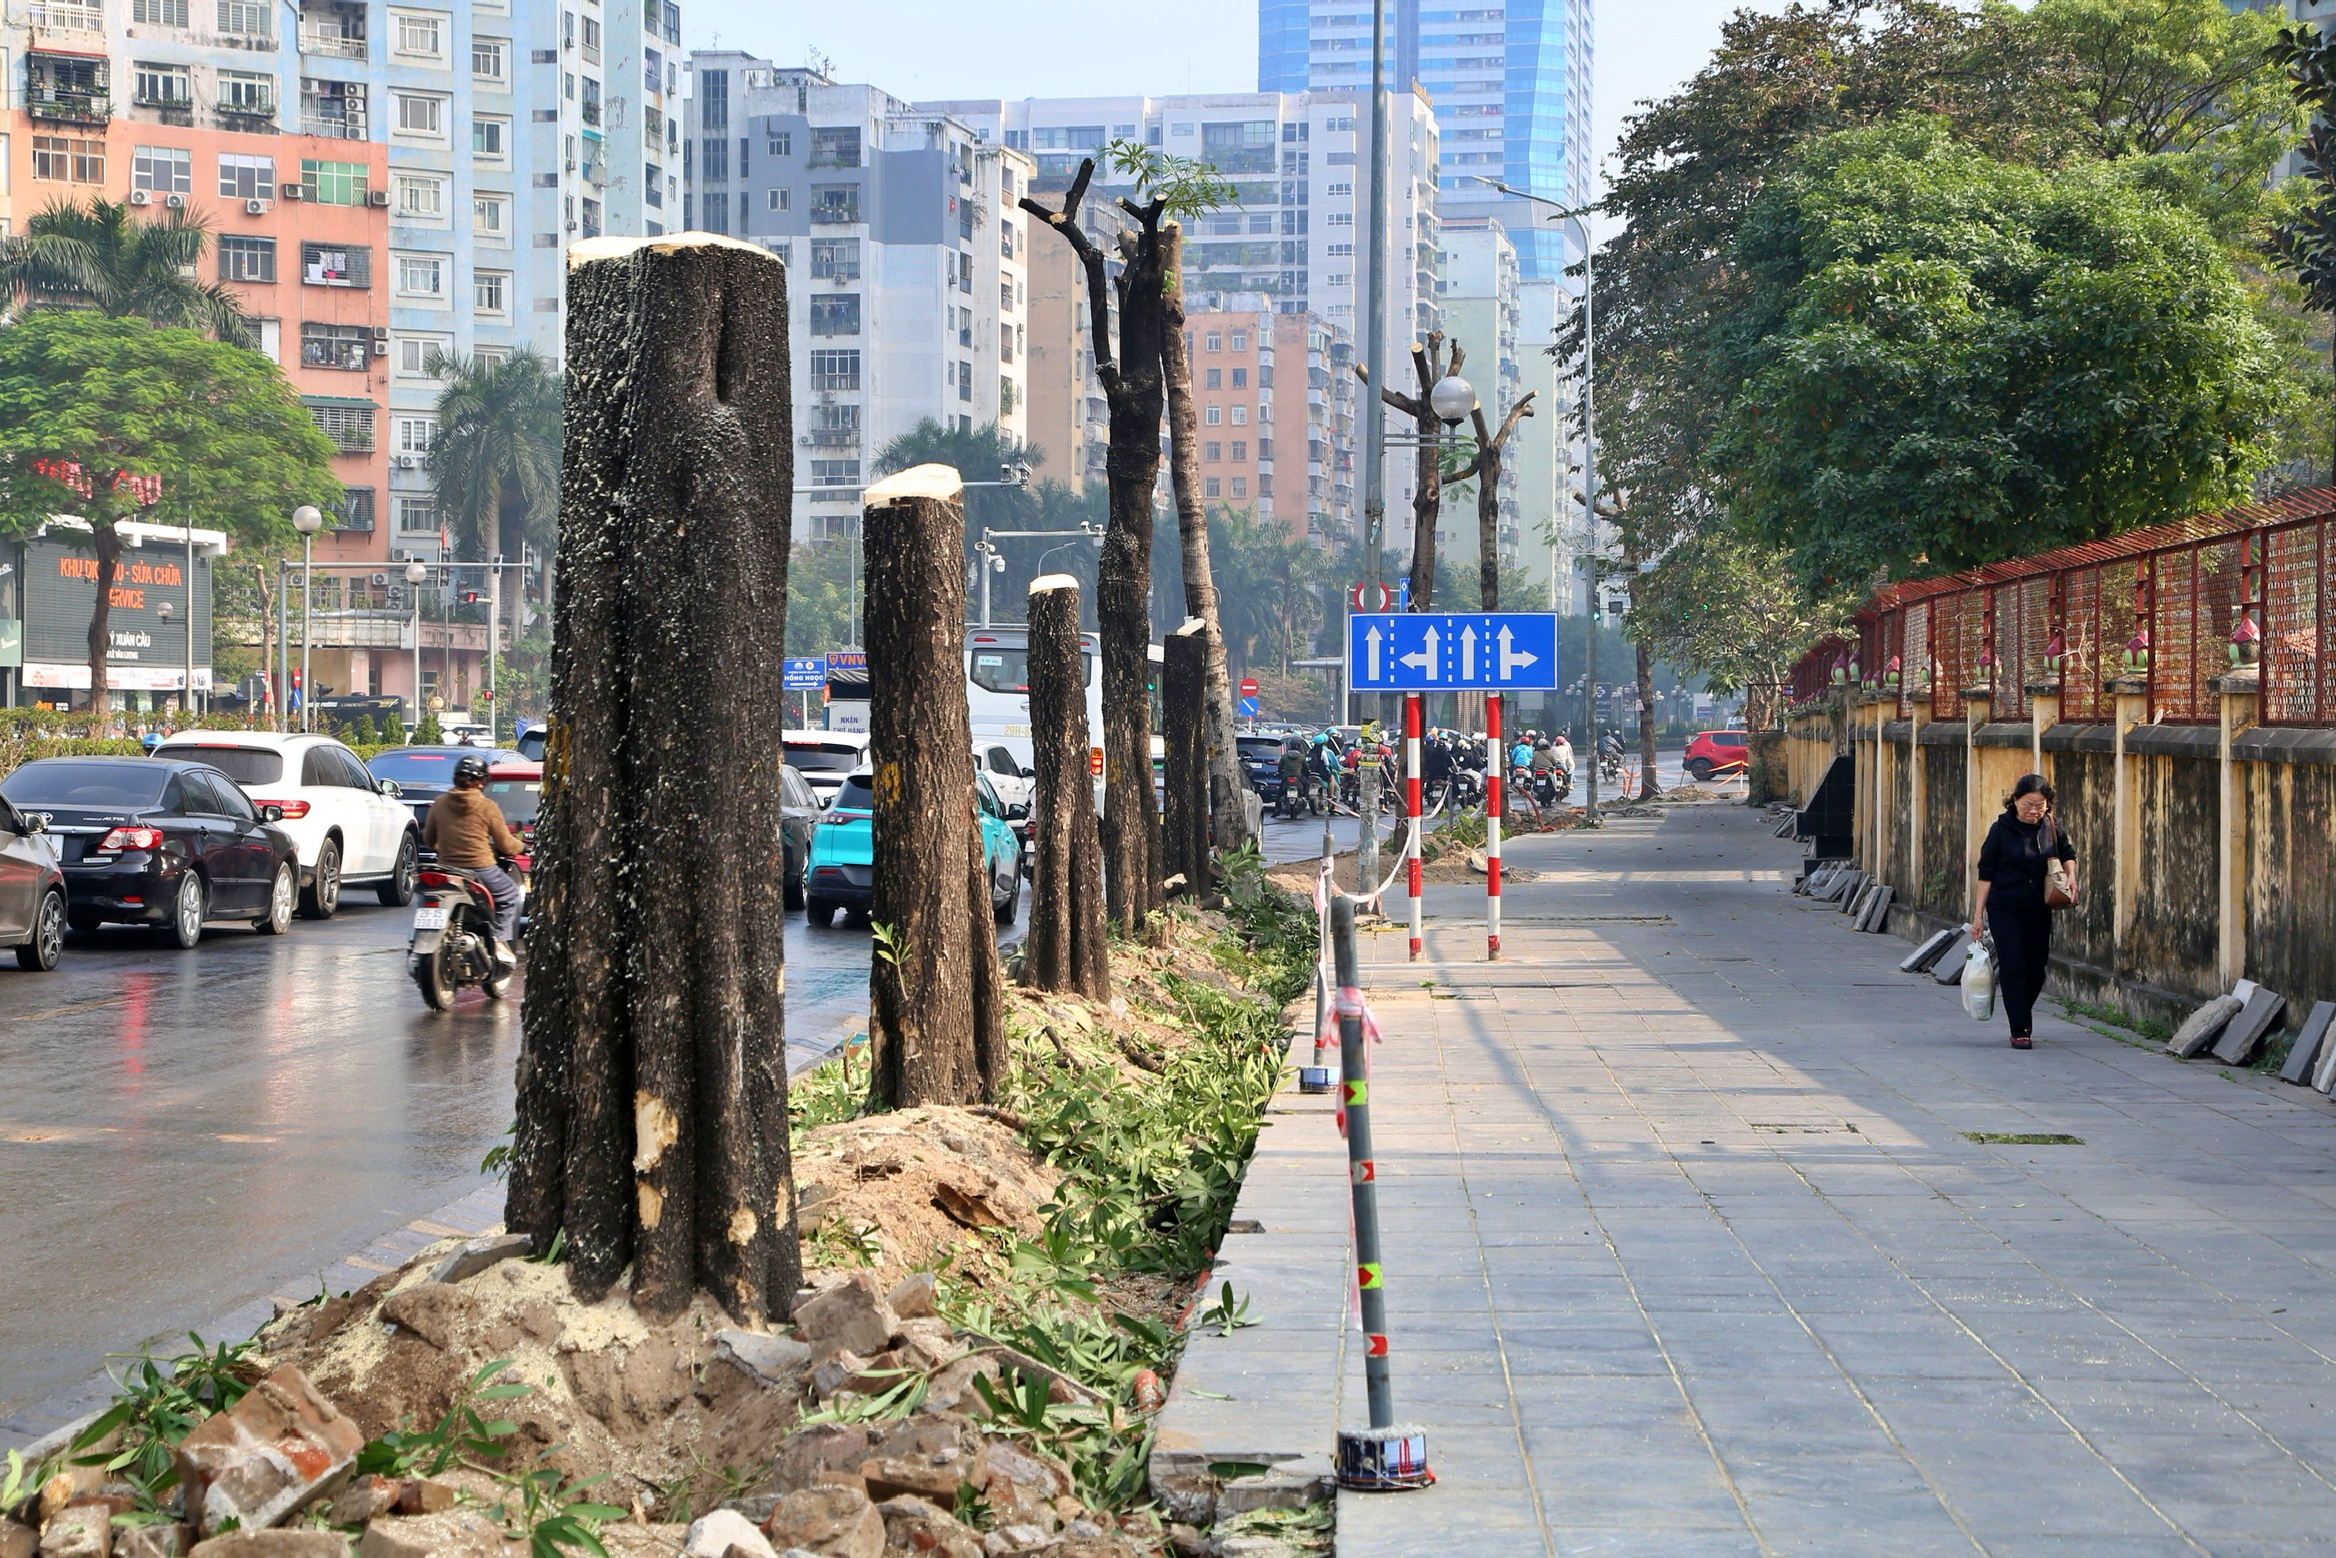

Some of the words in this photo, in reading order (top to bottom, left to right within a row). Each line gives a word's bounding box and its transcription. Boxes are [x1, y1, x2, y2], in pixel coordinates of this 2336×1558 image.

[60, 557, 82, 578] KHU
[85, 559, 100, 583] DỊC
[132, 560, 153, 585] SỬA
[154, 564, 182, 586] CHỮA
[109, 588, 145, 609] ERVICE
